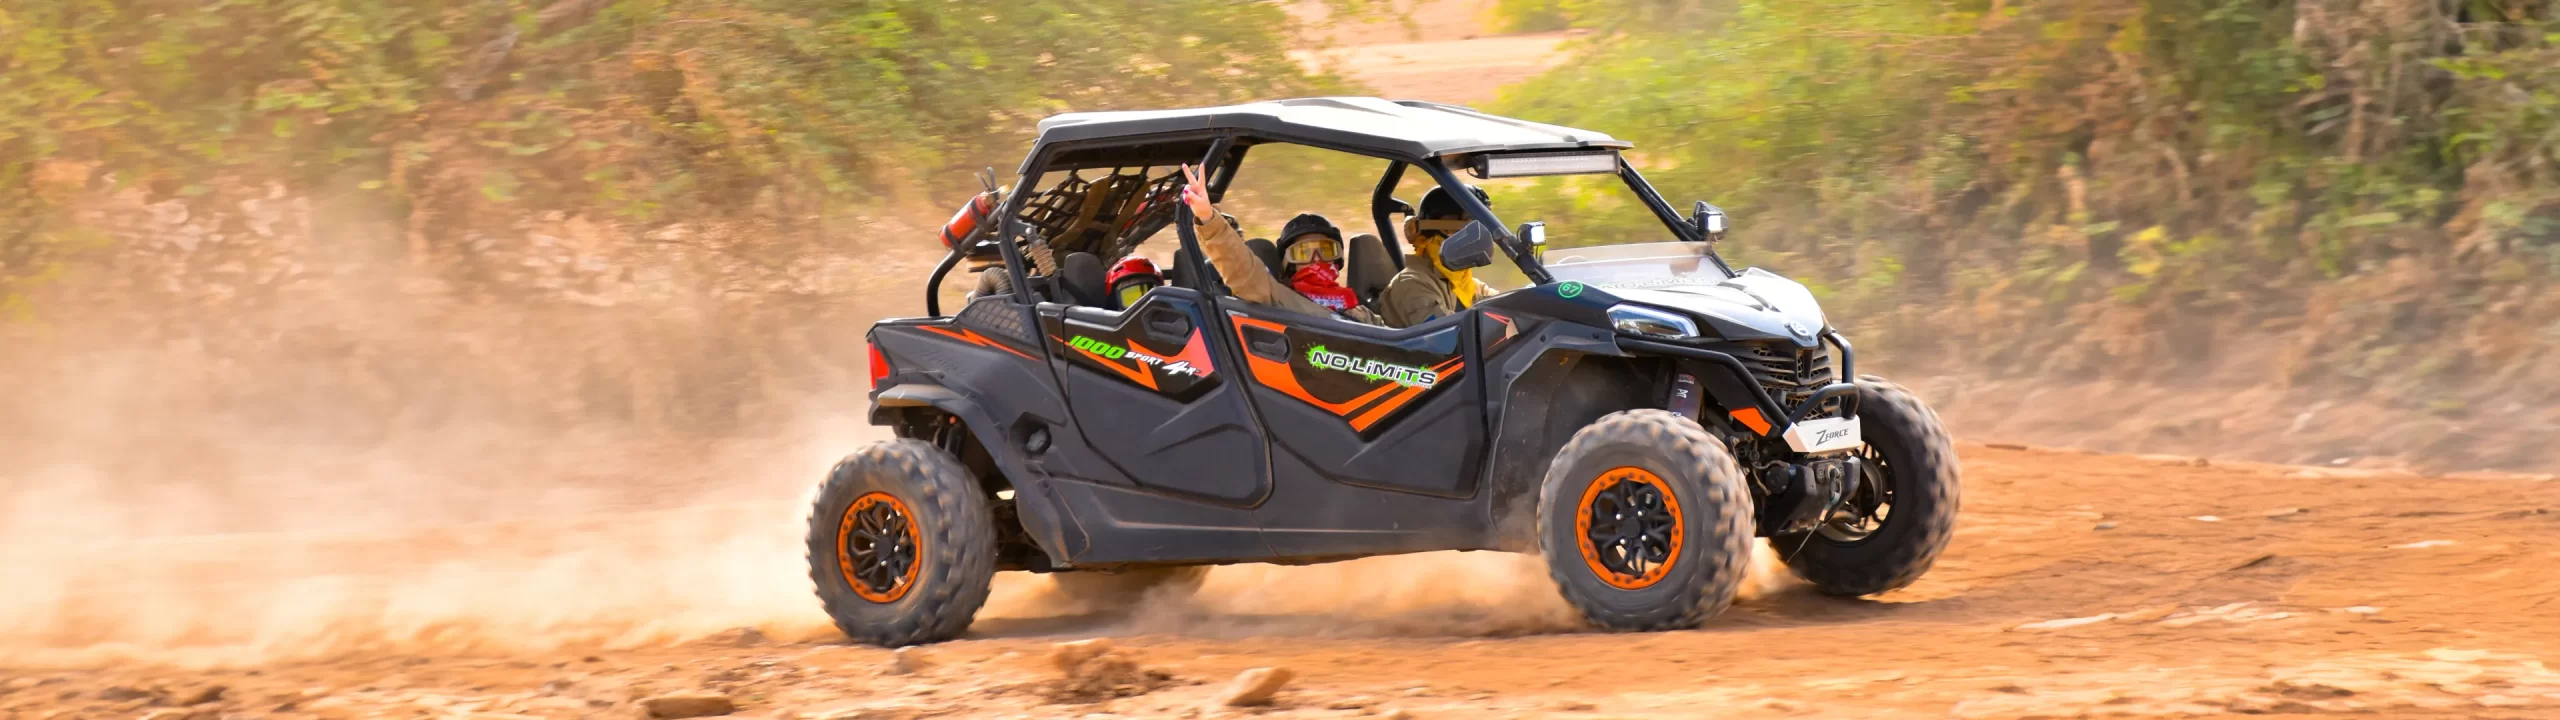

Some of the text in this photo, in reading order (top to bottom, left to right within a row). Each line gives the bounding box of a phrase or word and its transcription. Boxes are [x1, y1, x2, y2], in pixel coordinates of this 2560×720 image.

[1562, 283, 1580, 294] 67
[1070, 336, 1126, 359] 1000
[1125, 351, 1163, 366] SPORT
